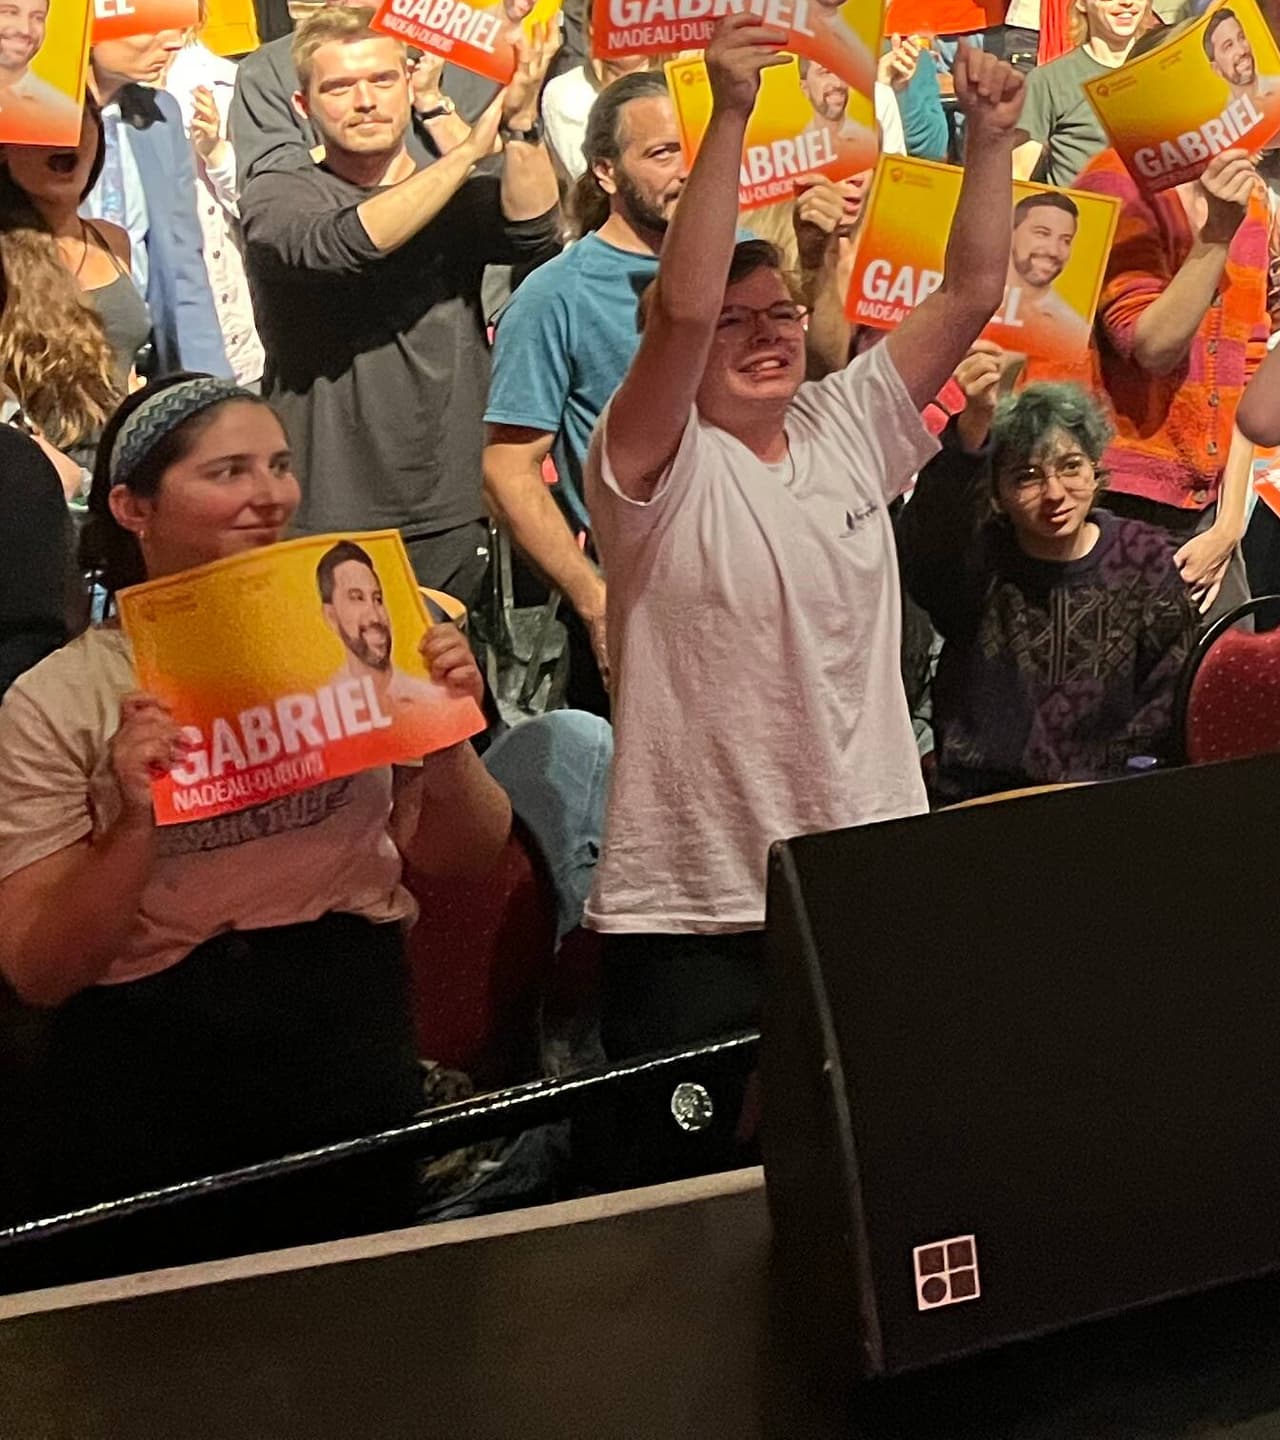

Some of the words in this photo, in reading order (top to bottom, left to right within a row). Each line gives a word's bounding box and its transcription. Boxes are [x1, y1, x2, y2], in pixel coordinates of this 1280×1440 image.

[739, 127, 838, 187] ABRIEL
[1134, 93, 1264, 178] GABRIEL
[171, 676, 393, 786] GABRIEL
